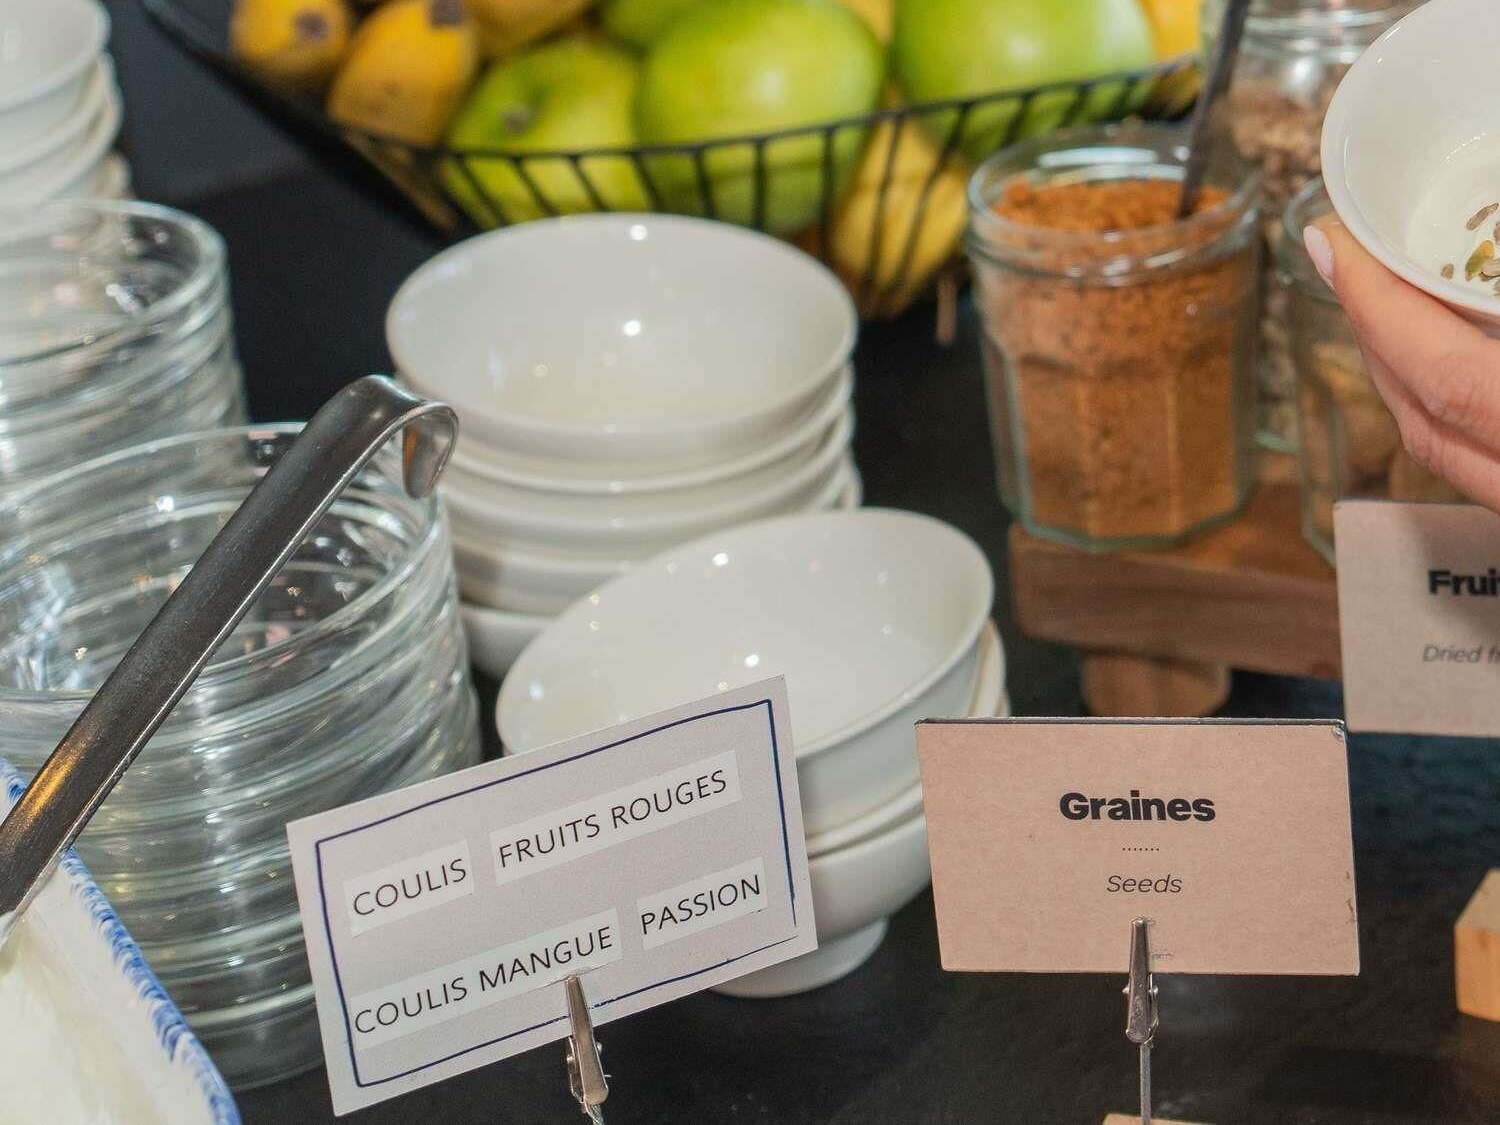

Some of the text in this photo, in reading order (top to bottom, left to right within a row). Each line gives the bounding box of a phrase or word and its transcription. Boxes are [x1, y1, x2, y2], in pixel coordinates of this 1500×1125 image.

[1422, 644, 1482, 666] Dried
[1059, 789, 1216, 822] Graines
[352, 769, 728, 917] COULIS FRUITS ROUGES
[1106, 873, 1183, 894] Seeds
[354, 874, 762, 1035] COULIS MANGUE PASSION
